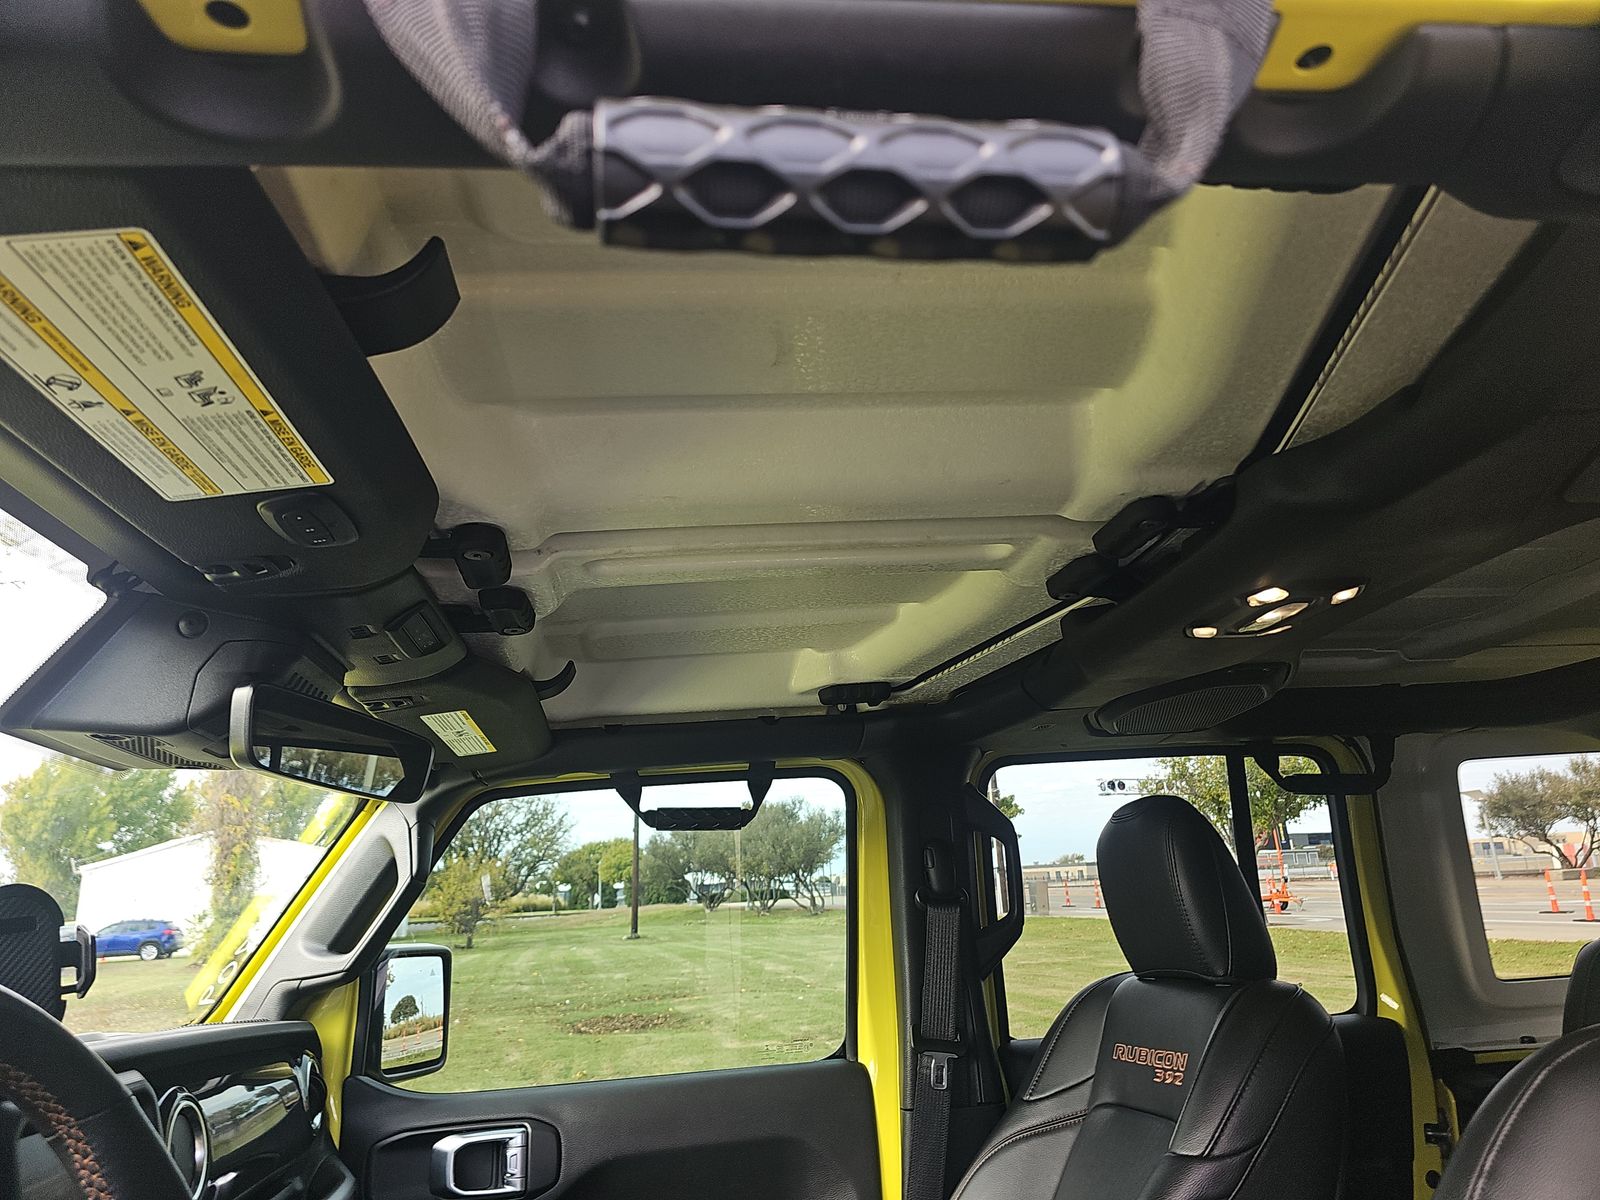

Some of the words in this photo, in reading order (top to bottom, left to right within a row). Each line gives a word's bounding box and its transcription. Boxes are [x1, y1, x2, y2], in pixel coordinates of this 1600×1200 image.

[141, 255, 192, 309] WARNING
[1112, 1043, 1189, 1071] RUBICON
[1153, 1069, 1185, 1086] 392
